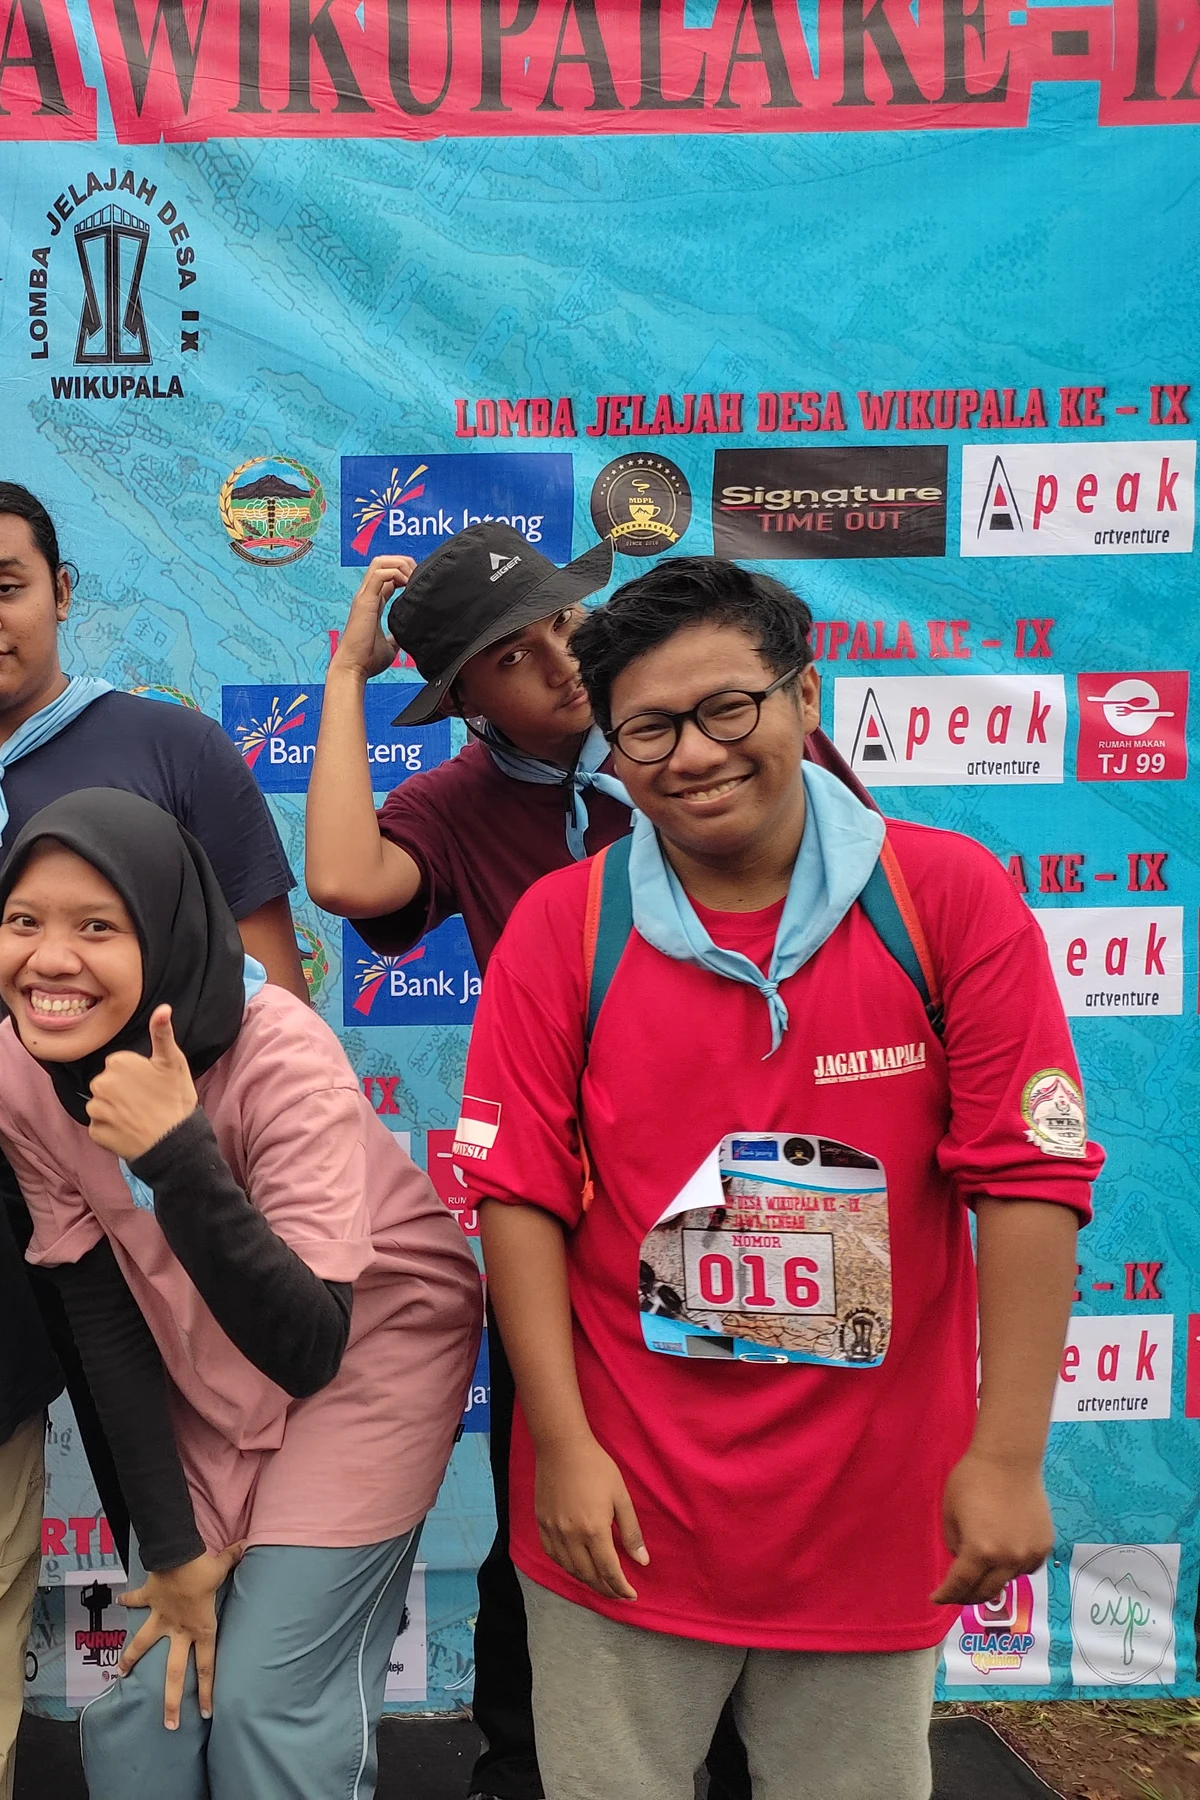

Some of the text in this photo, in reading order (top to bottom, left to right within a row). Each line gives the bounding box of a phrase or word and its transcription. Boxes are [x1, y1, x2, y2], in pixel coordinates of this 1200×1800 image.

[114, 0, 800, 117] WIKUPALA
[833, 0, 1009, 106] KE
[1123, 0, 1200, 102] I
[29, 246, 51, 360] LOMBA
[46, 168, 157, 237] JELAJAH
[157, 200, 197, 291] DESA
[51, 375, 185, 399] WIKUPALA
[455, 397, 578, 438] LOMBA
[586, 393, 744, 437] JELAJAH
[756, 391, 847, 432] DESA
[857, 388, 1048, 431] WIKUPALA
[1058, 387, 1105, 427] KE
[1149, 385, 1191, 425] IX
[721, 486, 942, 509] Signature
[390, 508, 450, 538] Bank
[758, 510, 905, 533] TIME OUT
[1093, 527, 1171, 546] artventure
[490, 556, 522, 582] EIGER
[929, 620, 970, 659] KE
[1014, 618, 1055, 659] IX
[270, 737, 423, 771] Ban teng
[1098, 740, 1166, 749] RUMAH MAKAN
[967, 759, 1040, 776] artventure
[1098, 753, 1165, 774] TJ 99
[1039, 855, 1085, 893] KE
[1127, 853, 1169, 892] IX
[390, 969, 456, 997] Bank
[1085, 991, 1159, 1008] artventure
[814, 1051, 868, 1078] JAGAT
[870, 1042, 926, 1070] MAPALA
[732, 1235, 782, 1248] NOMOR
[699, 1253, 821, 1308] 016
[1124, 1262, 1162, 1300] IX
[1077, 1396, 1148, 1412] artventure
[961, 1634, 1033, 1652] CILACAP
